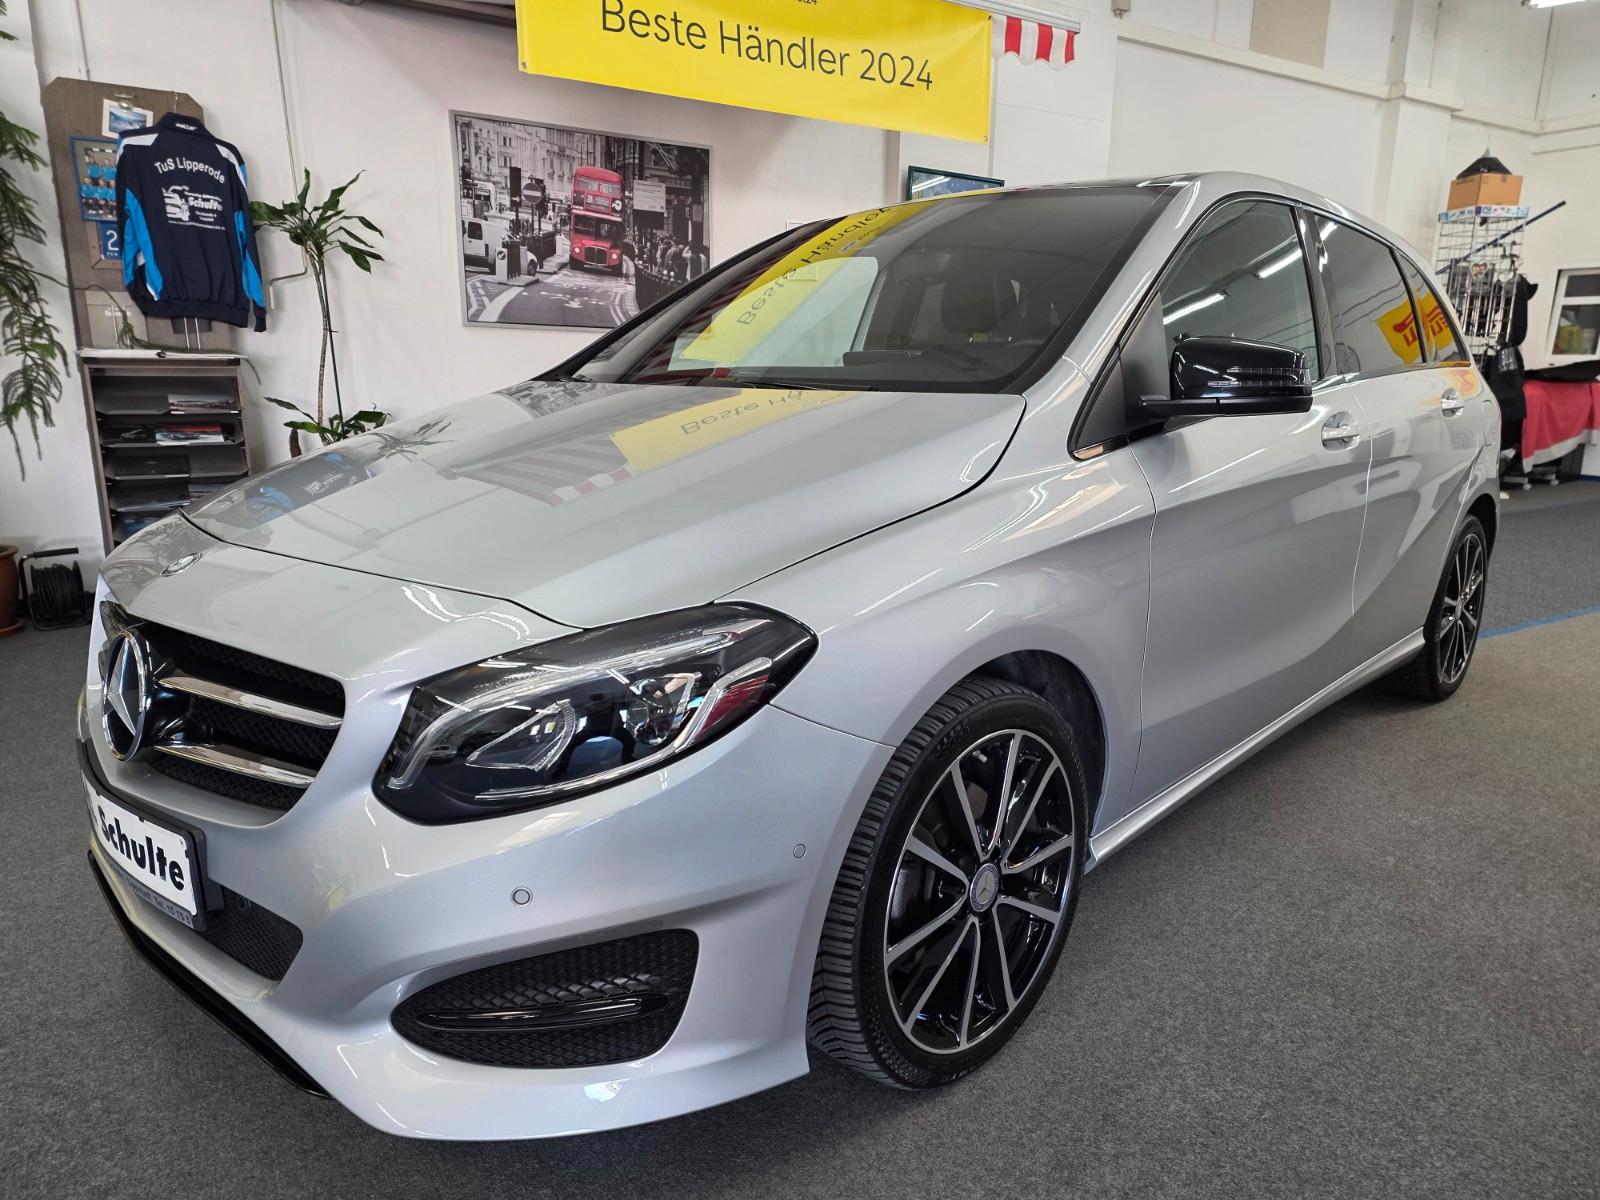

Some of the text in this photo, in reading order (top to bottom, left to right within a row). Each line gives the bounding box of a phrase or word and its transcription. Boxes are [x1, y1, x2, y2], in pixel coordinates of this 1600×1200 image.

[602, 0, 933, 91] Beste Händler 2024
[154, 157, 225, 184] TuS Lipperode
[187, 196, 223, 212] Schulte
[97, 804, 185, 891] Schulte
